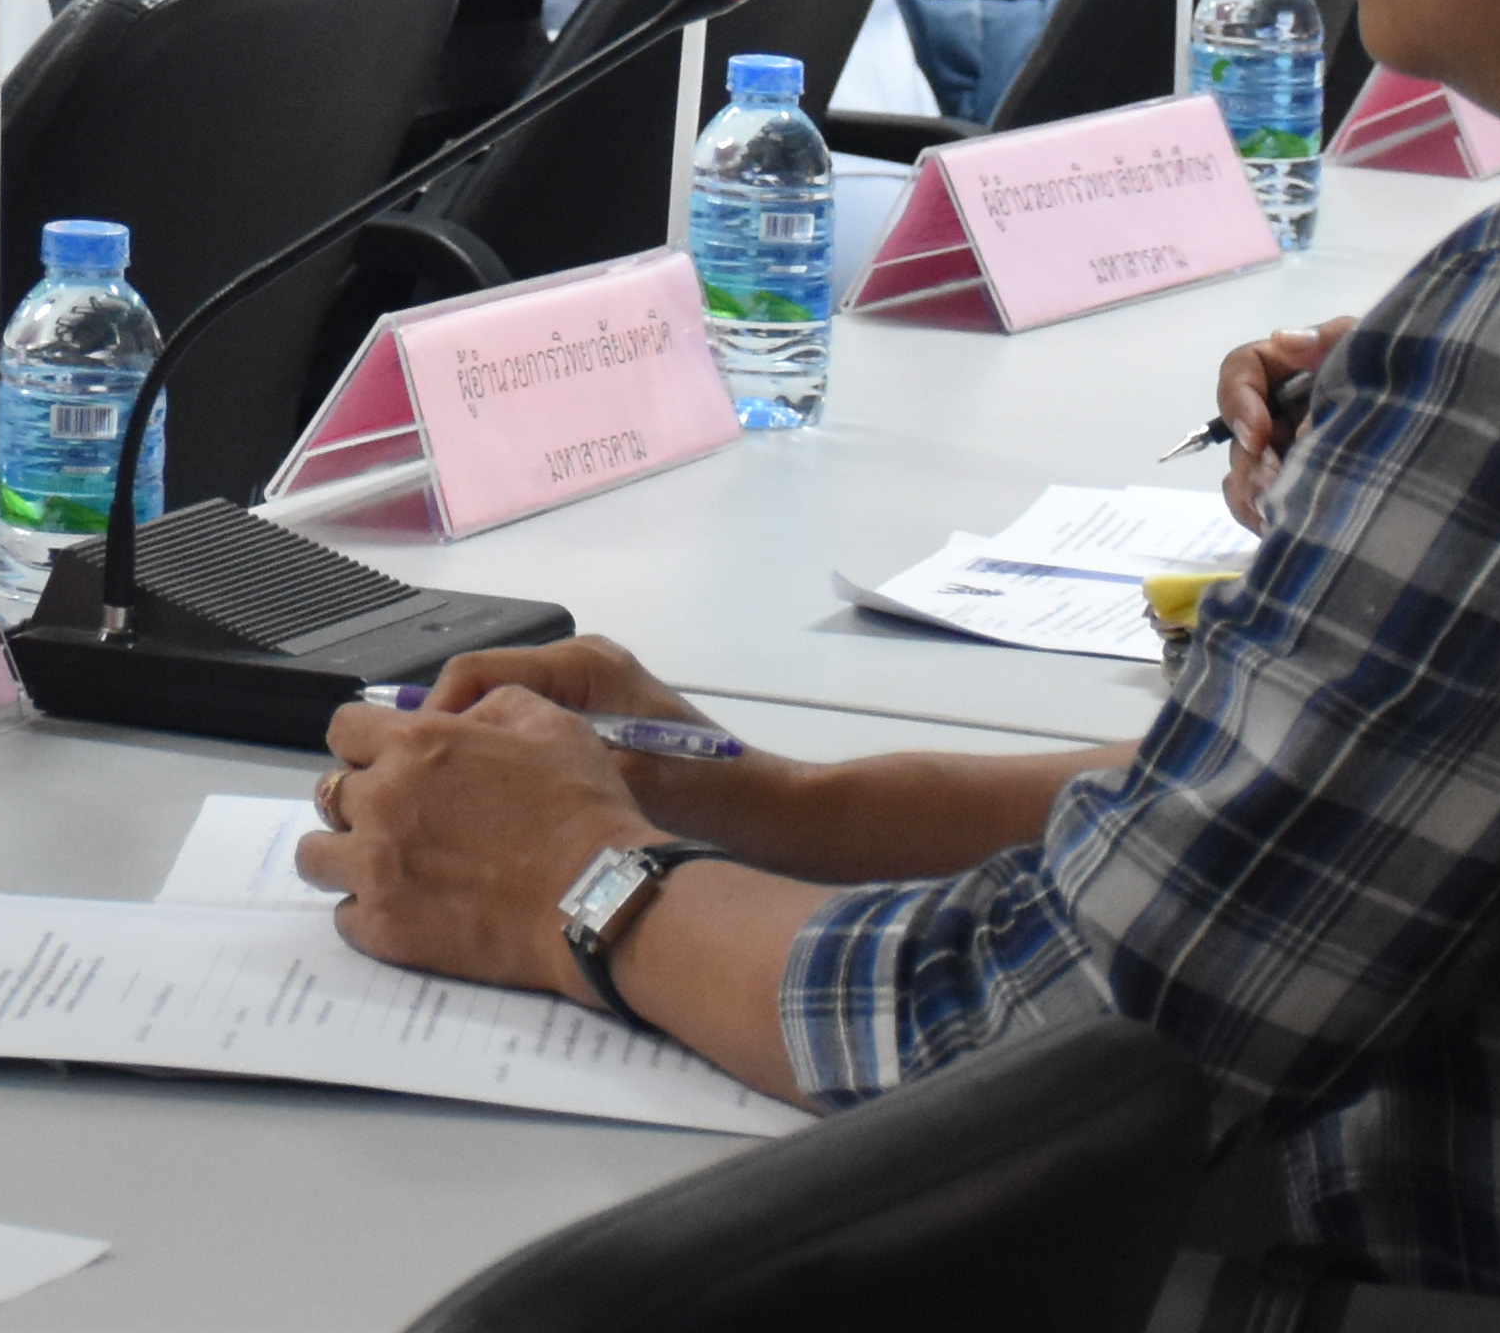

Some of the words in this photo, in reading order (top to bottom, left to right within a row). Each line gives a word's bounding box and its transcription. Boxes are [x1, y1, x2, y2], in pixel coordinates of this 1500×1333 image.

[979, 145, 1224, 232] ผู้อำนวยการวิทยาลัยอาชีวศึกษา
[1088, 244, 1189, 285] มหาสารคาม
[457, 309, 673, 419] ผู้อำนวยการวิทยาลัยเทคนิค
[545, 430, 648, 483] มหาสารคาม
